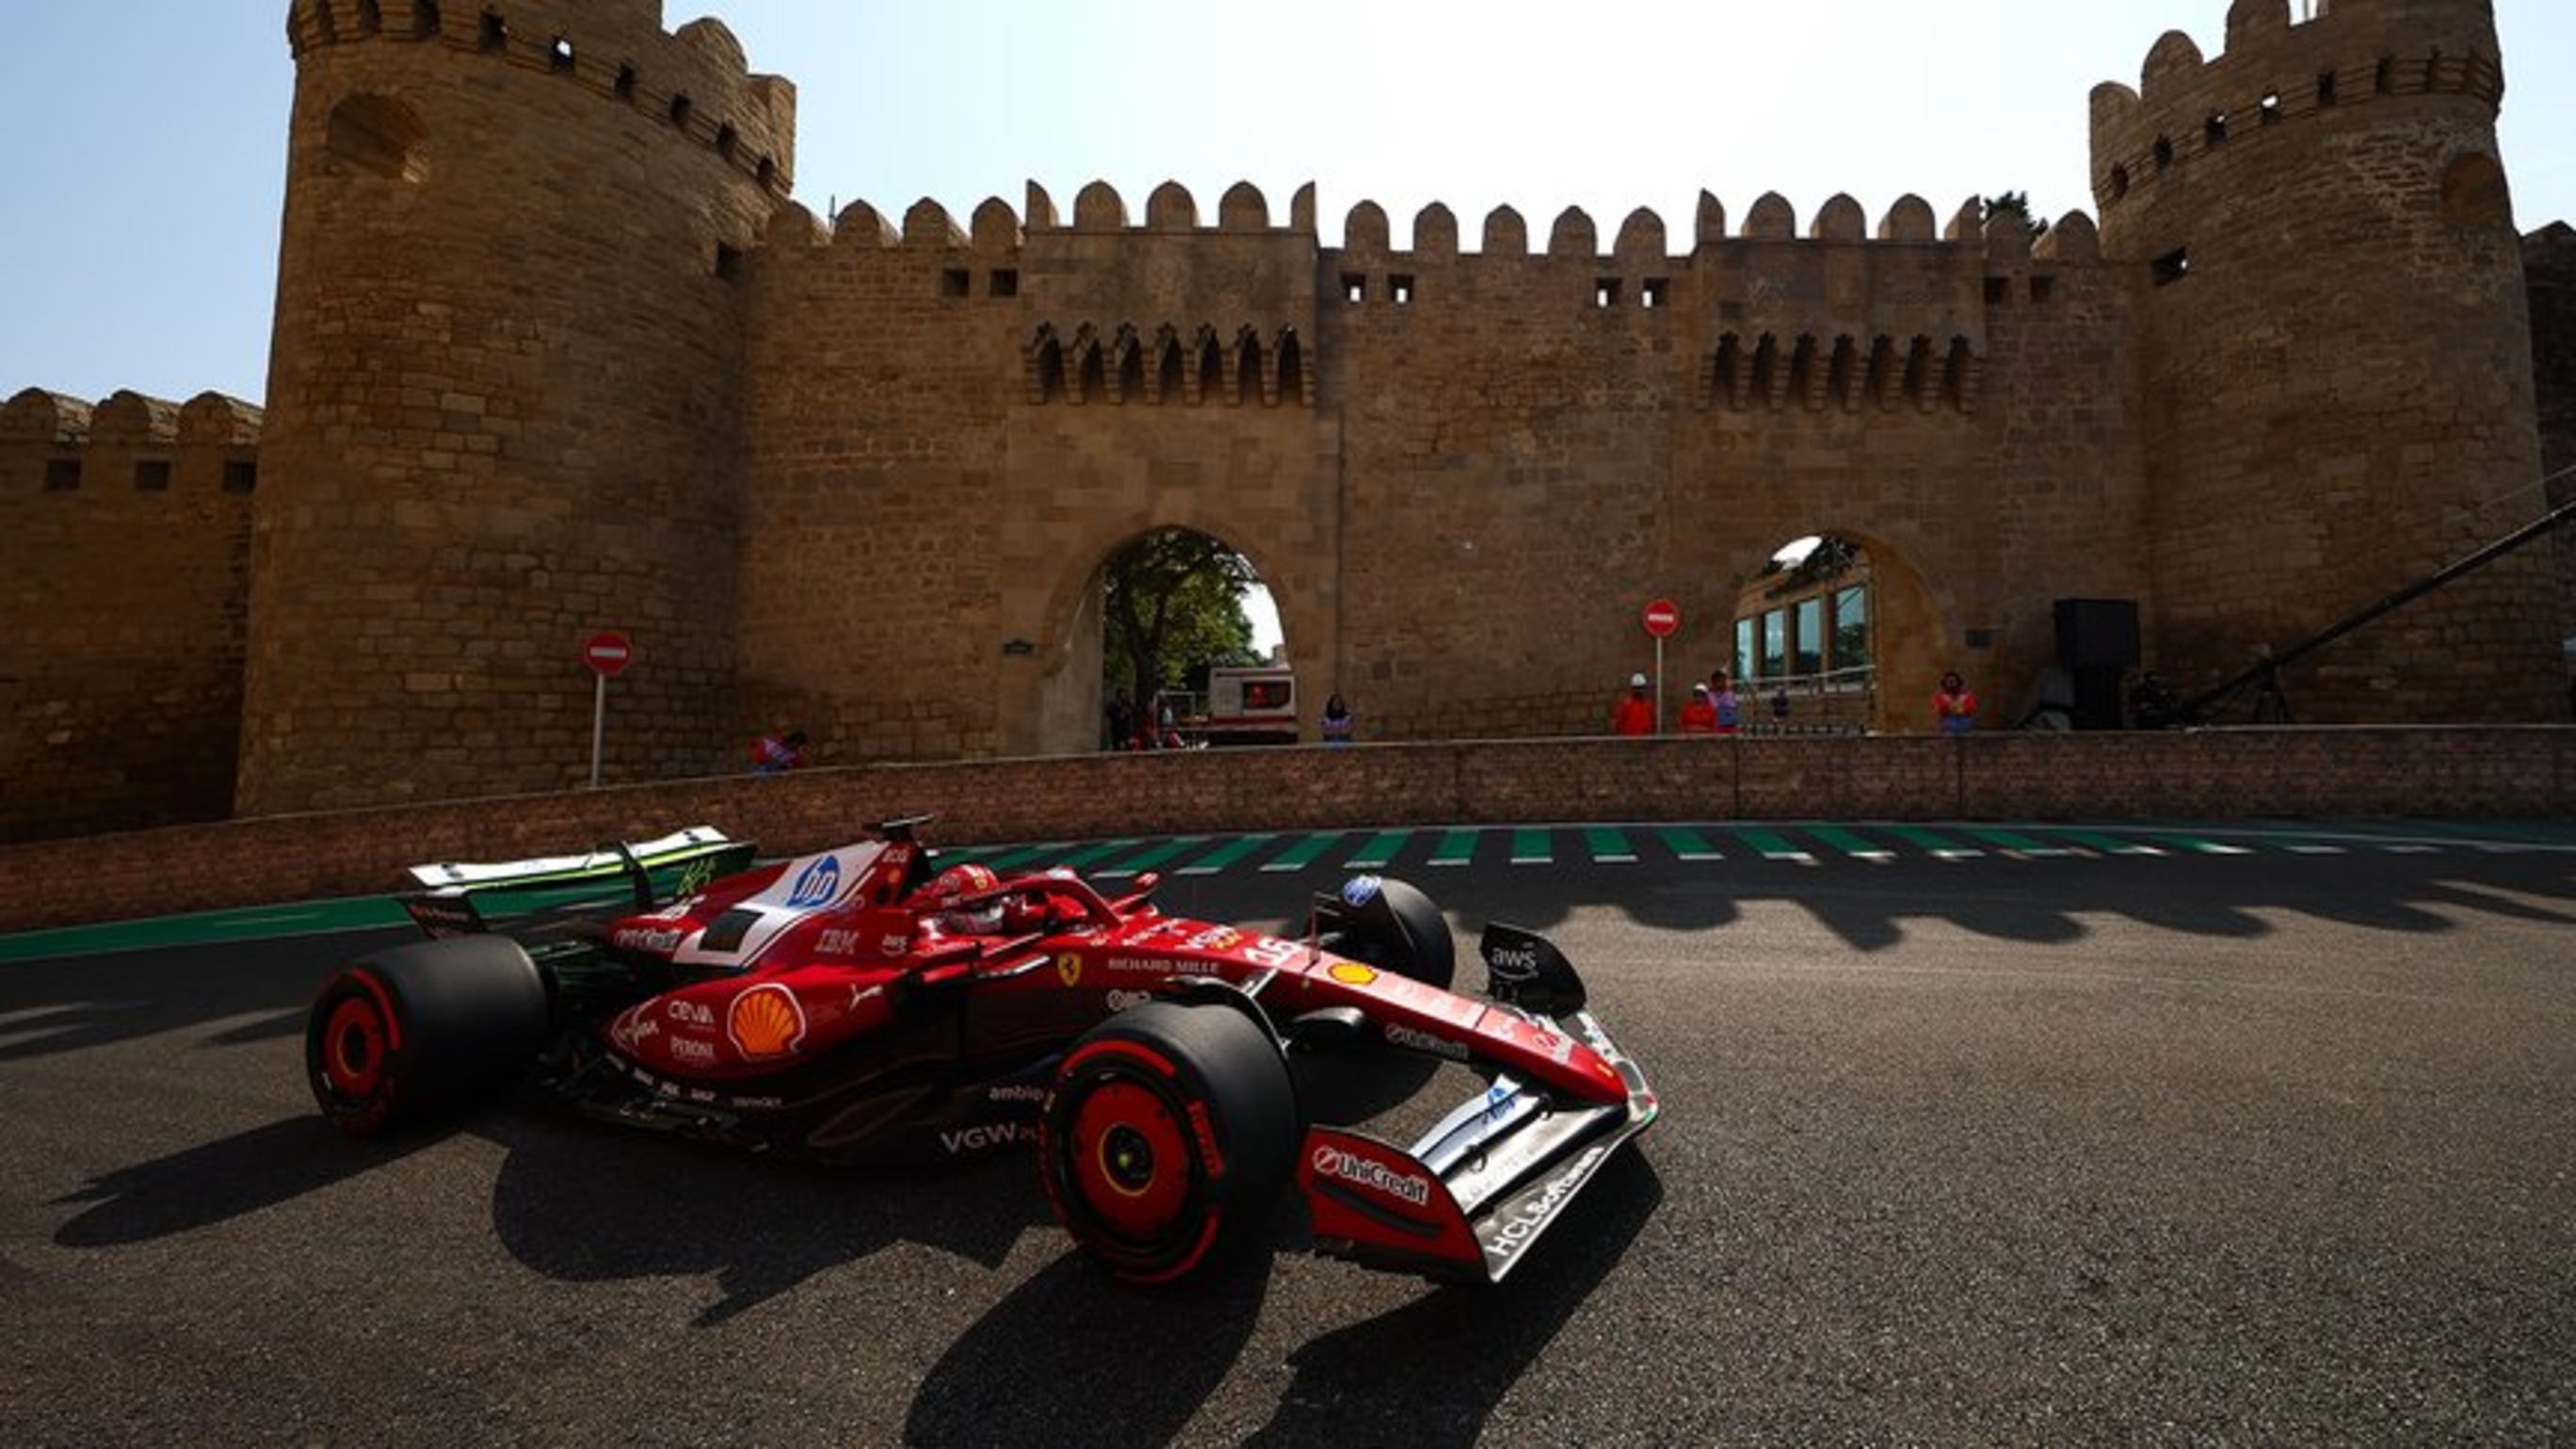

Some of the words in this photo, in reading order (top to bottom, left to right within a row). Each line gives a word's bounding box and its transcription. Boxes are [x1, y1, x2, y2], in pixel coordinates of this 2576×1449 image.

[813, 929, 859, 955] IBM
[1108, 958, 1172, 973] RICHARD
[1176, 959, 1220, 974] MILLE
[1491, 946, 1537, 970] aws
[668, 1000, 714, 1024] CEVA
[940, 1120, 1016, 1154] VGW
[1337, 1151, 1429, 1206] UniCredit
